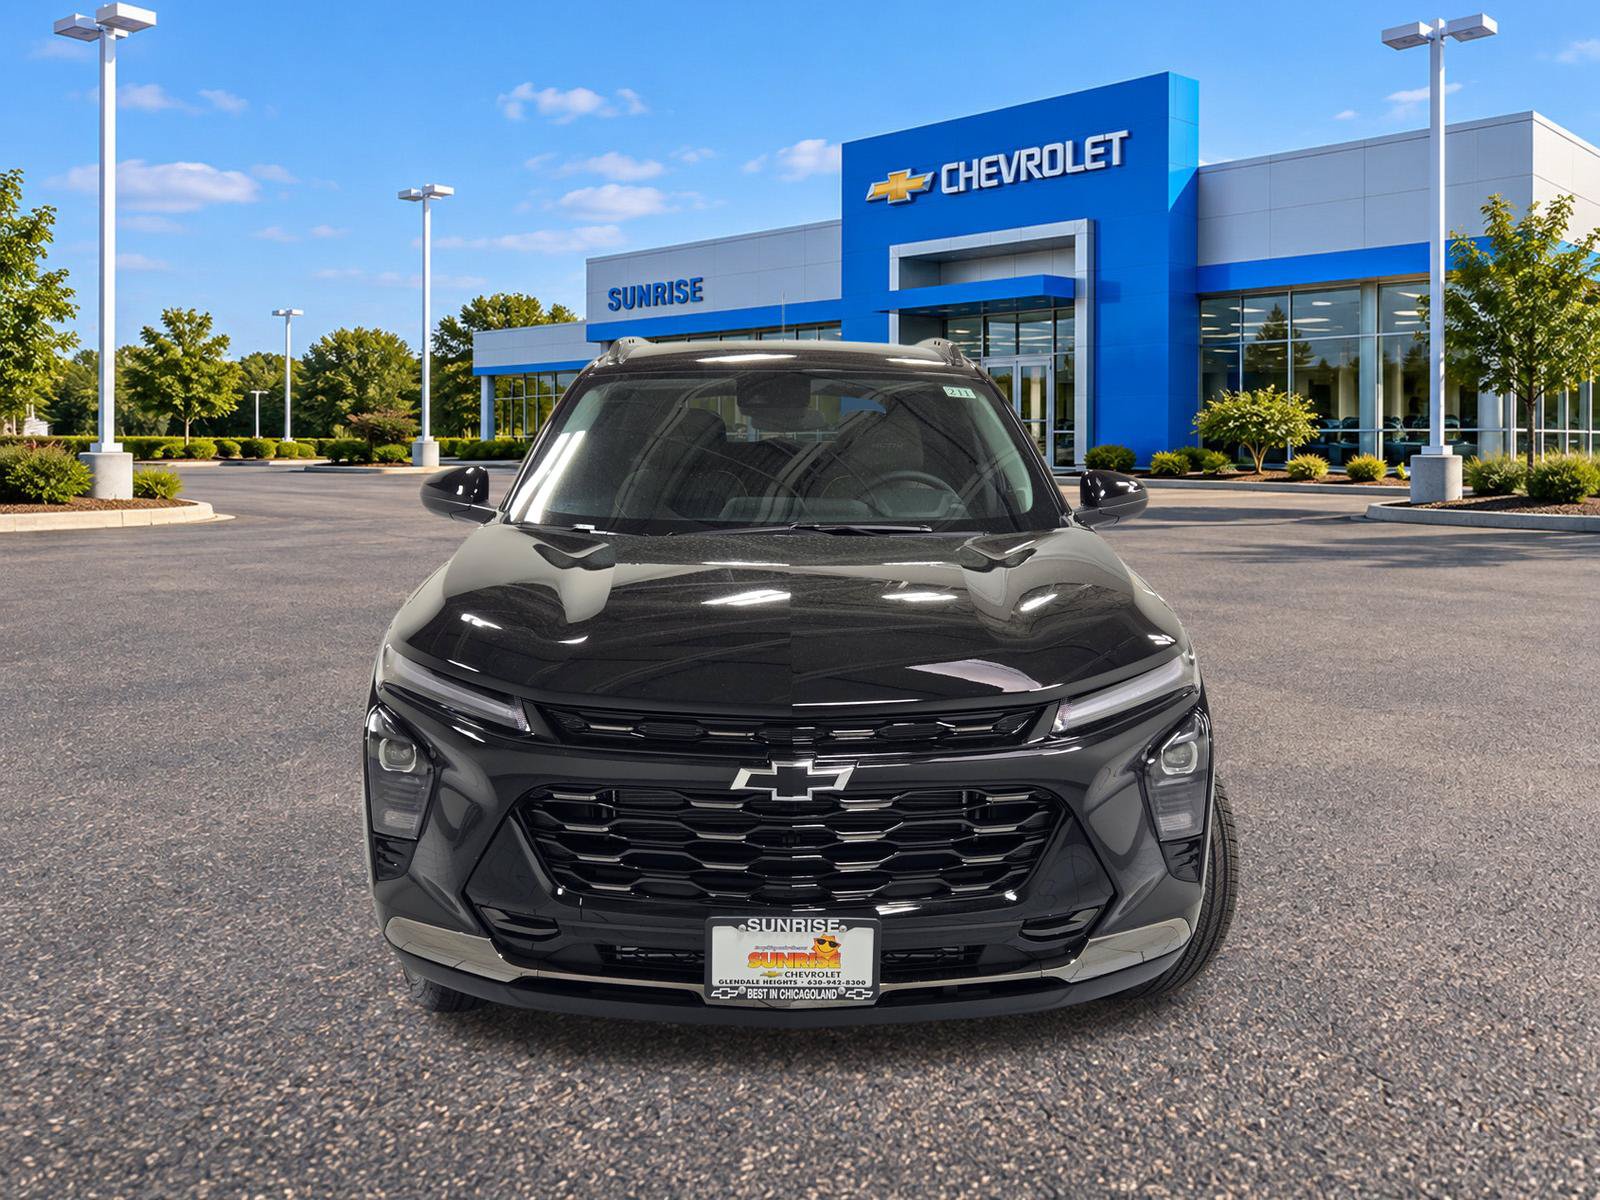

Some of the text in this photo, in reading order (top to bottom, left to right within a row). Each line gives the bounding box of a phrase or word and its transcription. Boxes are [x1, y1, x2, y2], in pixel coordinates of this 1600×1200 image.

[941, 130, 1129, 194] CHEVROLET
[608, 277, 704, 312] SUNRISE
[747, 918, 840, 933] SUNRISE
[748, 951, 841, 969] SUNRISE
[784, 970, 841, 978] CHEVROLET
[747, 988, 838, 1000] BEST IN CHICAGOLAND
